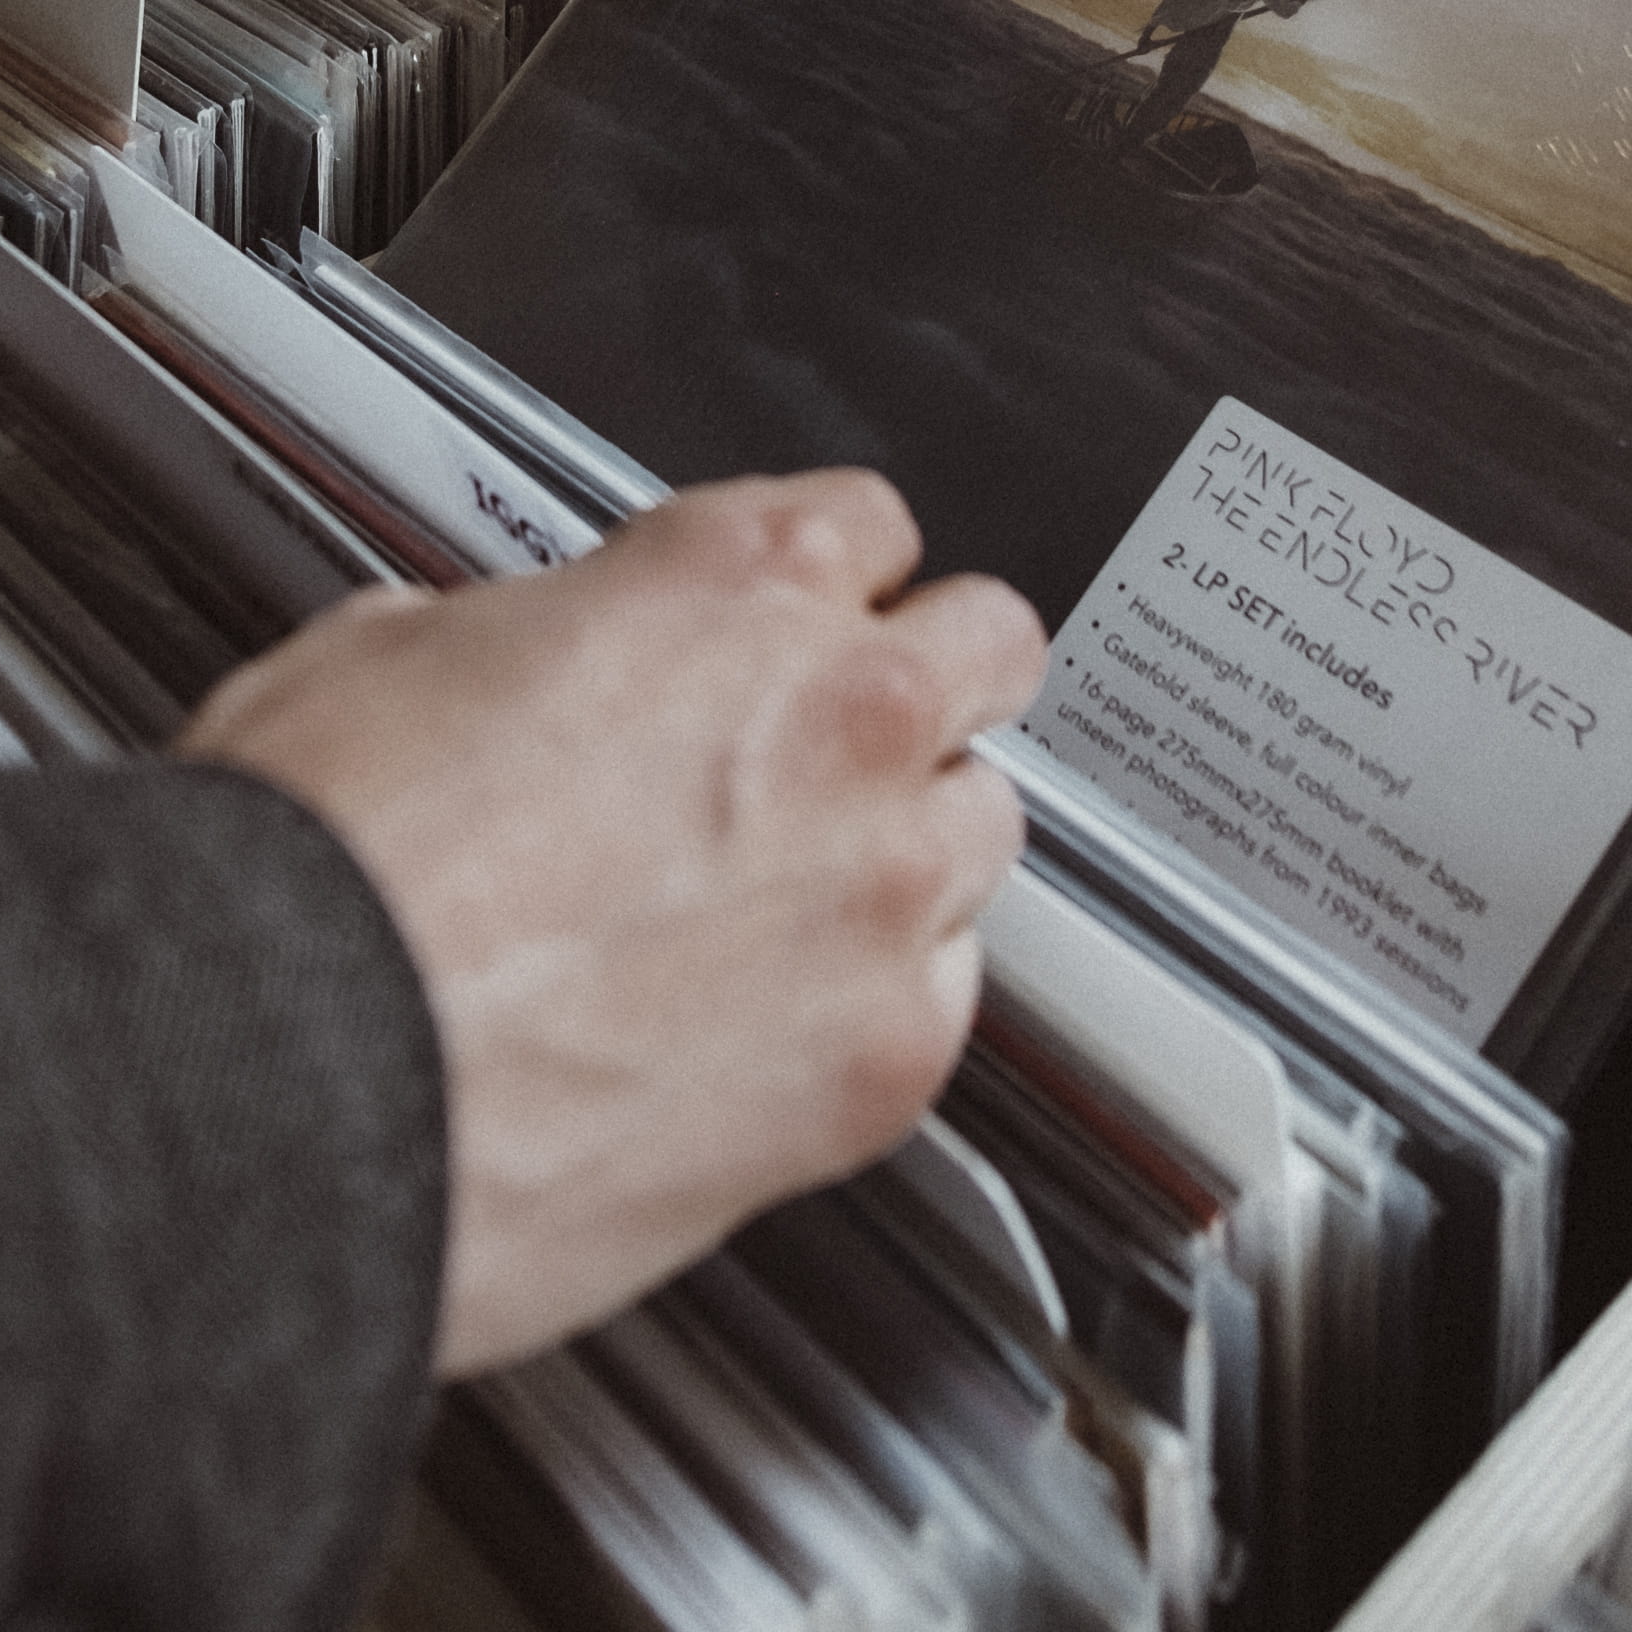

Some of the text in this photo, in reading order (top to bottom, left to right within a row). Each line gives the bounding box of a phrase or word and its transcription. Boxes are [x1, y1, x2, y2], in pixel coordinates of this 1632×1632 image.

[1192, 465, 1599, 750] THE ENDLESS RIVER
[1207, 428, 1456, 595] PINK FLOYD
[1227, 585, 1285, 631] SET
[1281, 619, 1394, 710] includes
[1079, 671, 1156, 739] 16-page
[1156, 728, 1324, 858] 275mmx275mm
[1326, 847, 1414, 925] booklet
[1416, 920, 1465, 962] with
[1103, 632, 1191, 703] Gatefold
[1260, 740, 1298, 777] full
[1295, 771, 1365, 825] colour
[1368, 823, 1427, 869] inner
[1428, 857, 1488, 917] bags
[1128, 594, 1413, 799] Heavyweight 180 gram vinyl
[1057, 702, 1127, 761] unseen
[1124, 752, 1257, 857] photographs
[1260, 843, 1312, 896] from
[1317, 884, 1373, 939] 1993
[1373, 933, 1469, 1014] sessions
